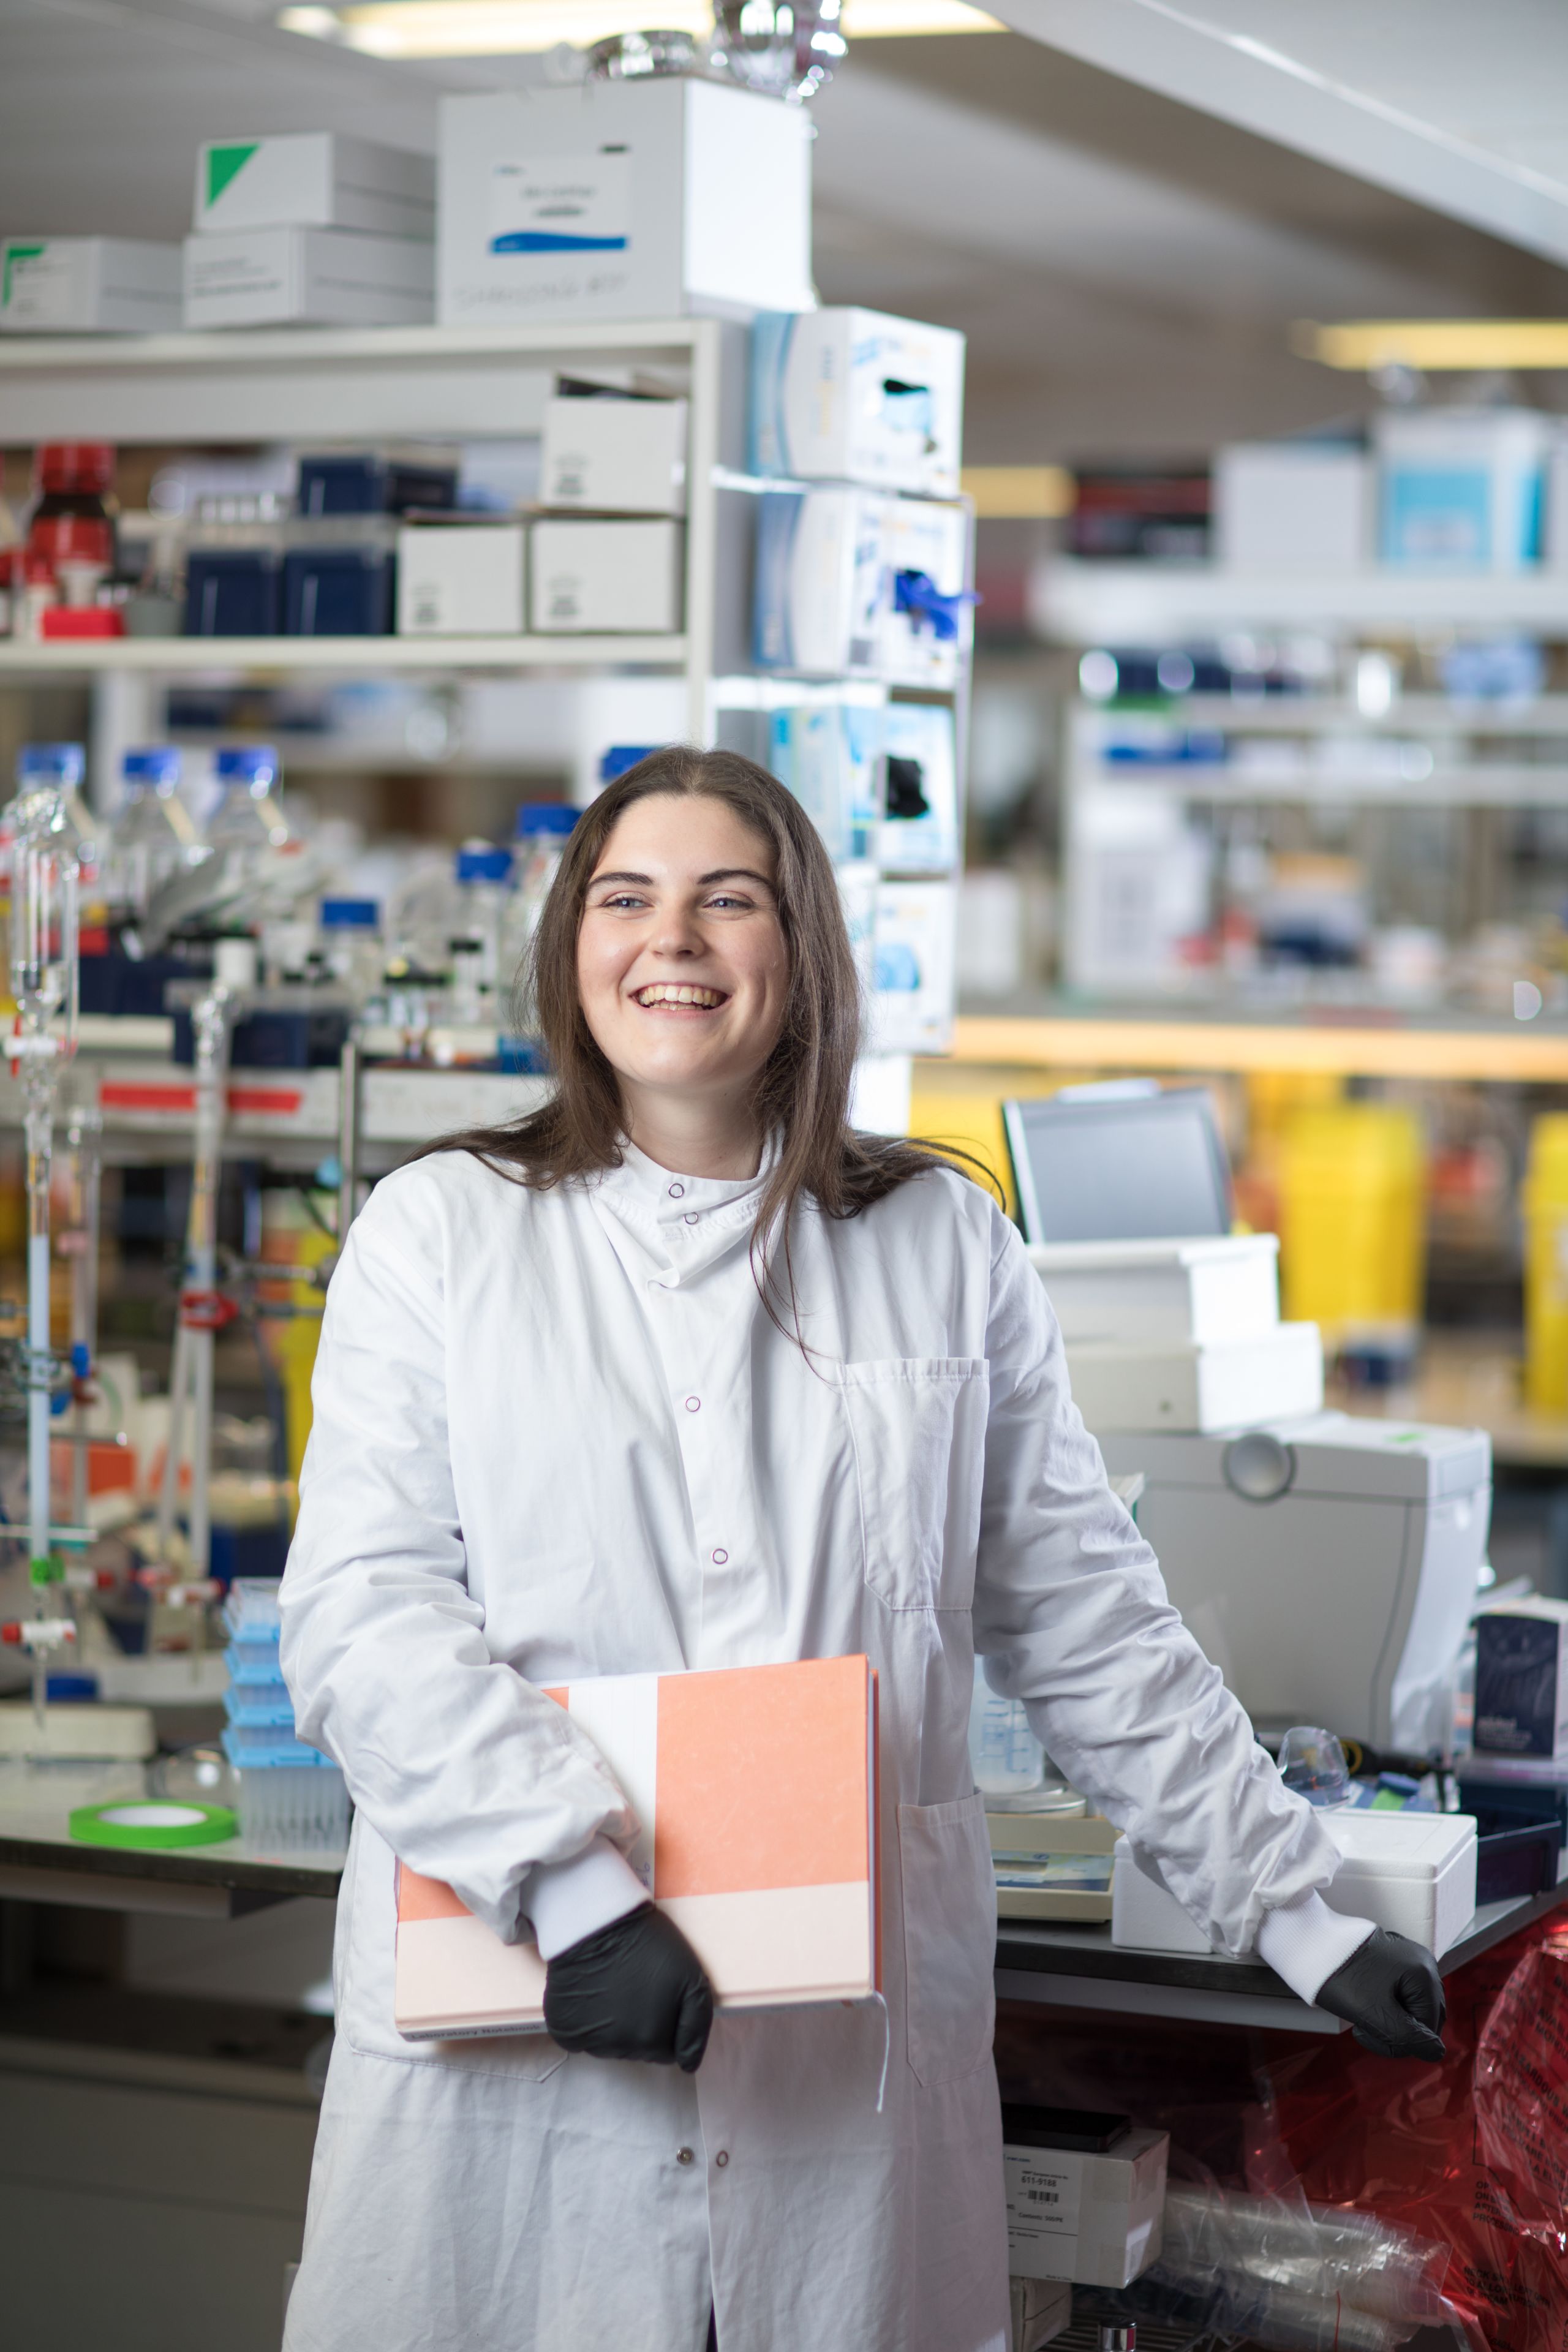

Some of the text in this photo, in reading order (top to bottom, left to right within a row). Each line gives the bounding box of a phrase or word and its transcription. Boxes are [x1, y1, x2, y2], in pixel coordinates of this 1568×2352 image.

[411, 2024, 541, 2040] Laboratory Notebook
[1021, 2176, 1057, 2187] 611-9188
